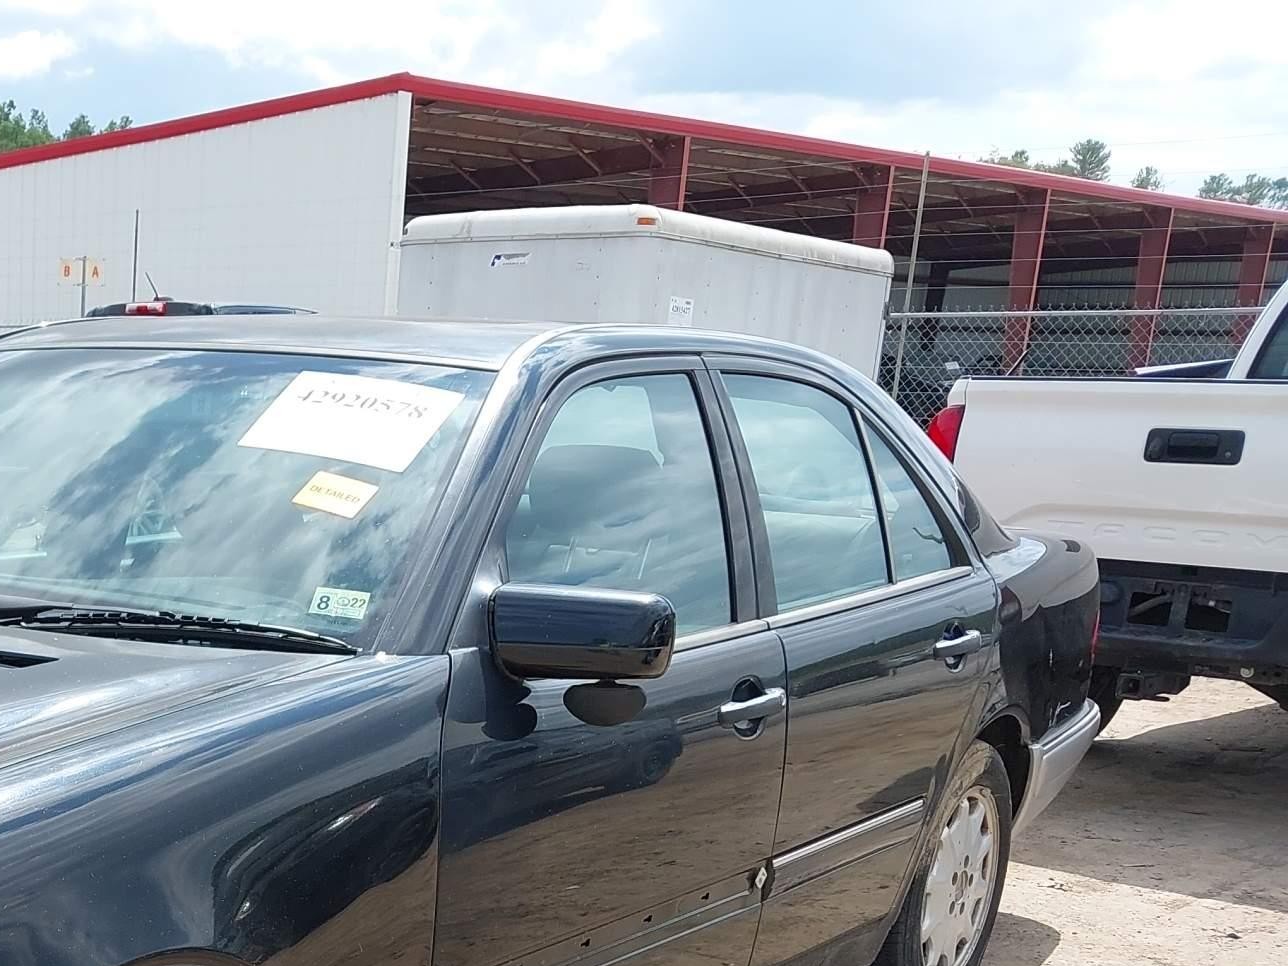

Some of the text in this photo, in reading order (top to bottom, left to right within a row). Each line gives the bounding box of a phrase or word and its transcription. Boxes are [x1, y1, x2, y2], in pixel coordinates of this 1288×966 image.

[63, 265, 71, 278] B
[91, 265, 100, 279] A
[296, 388, 429, 419] 42920578
[309, 484, 361, 504] DETAILED
[316, 595, 331, 611] 8
